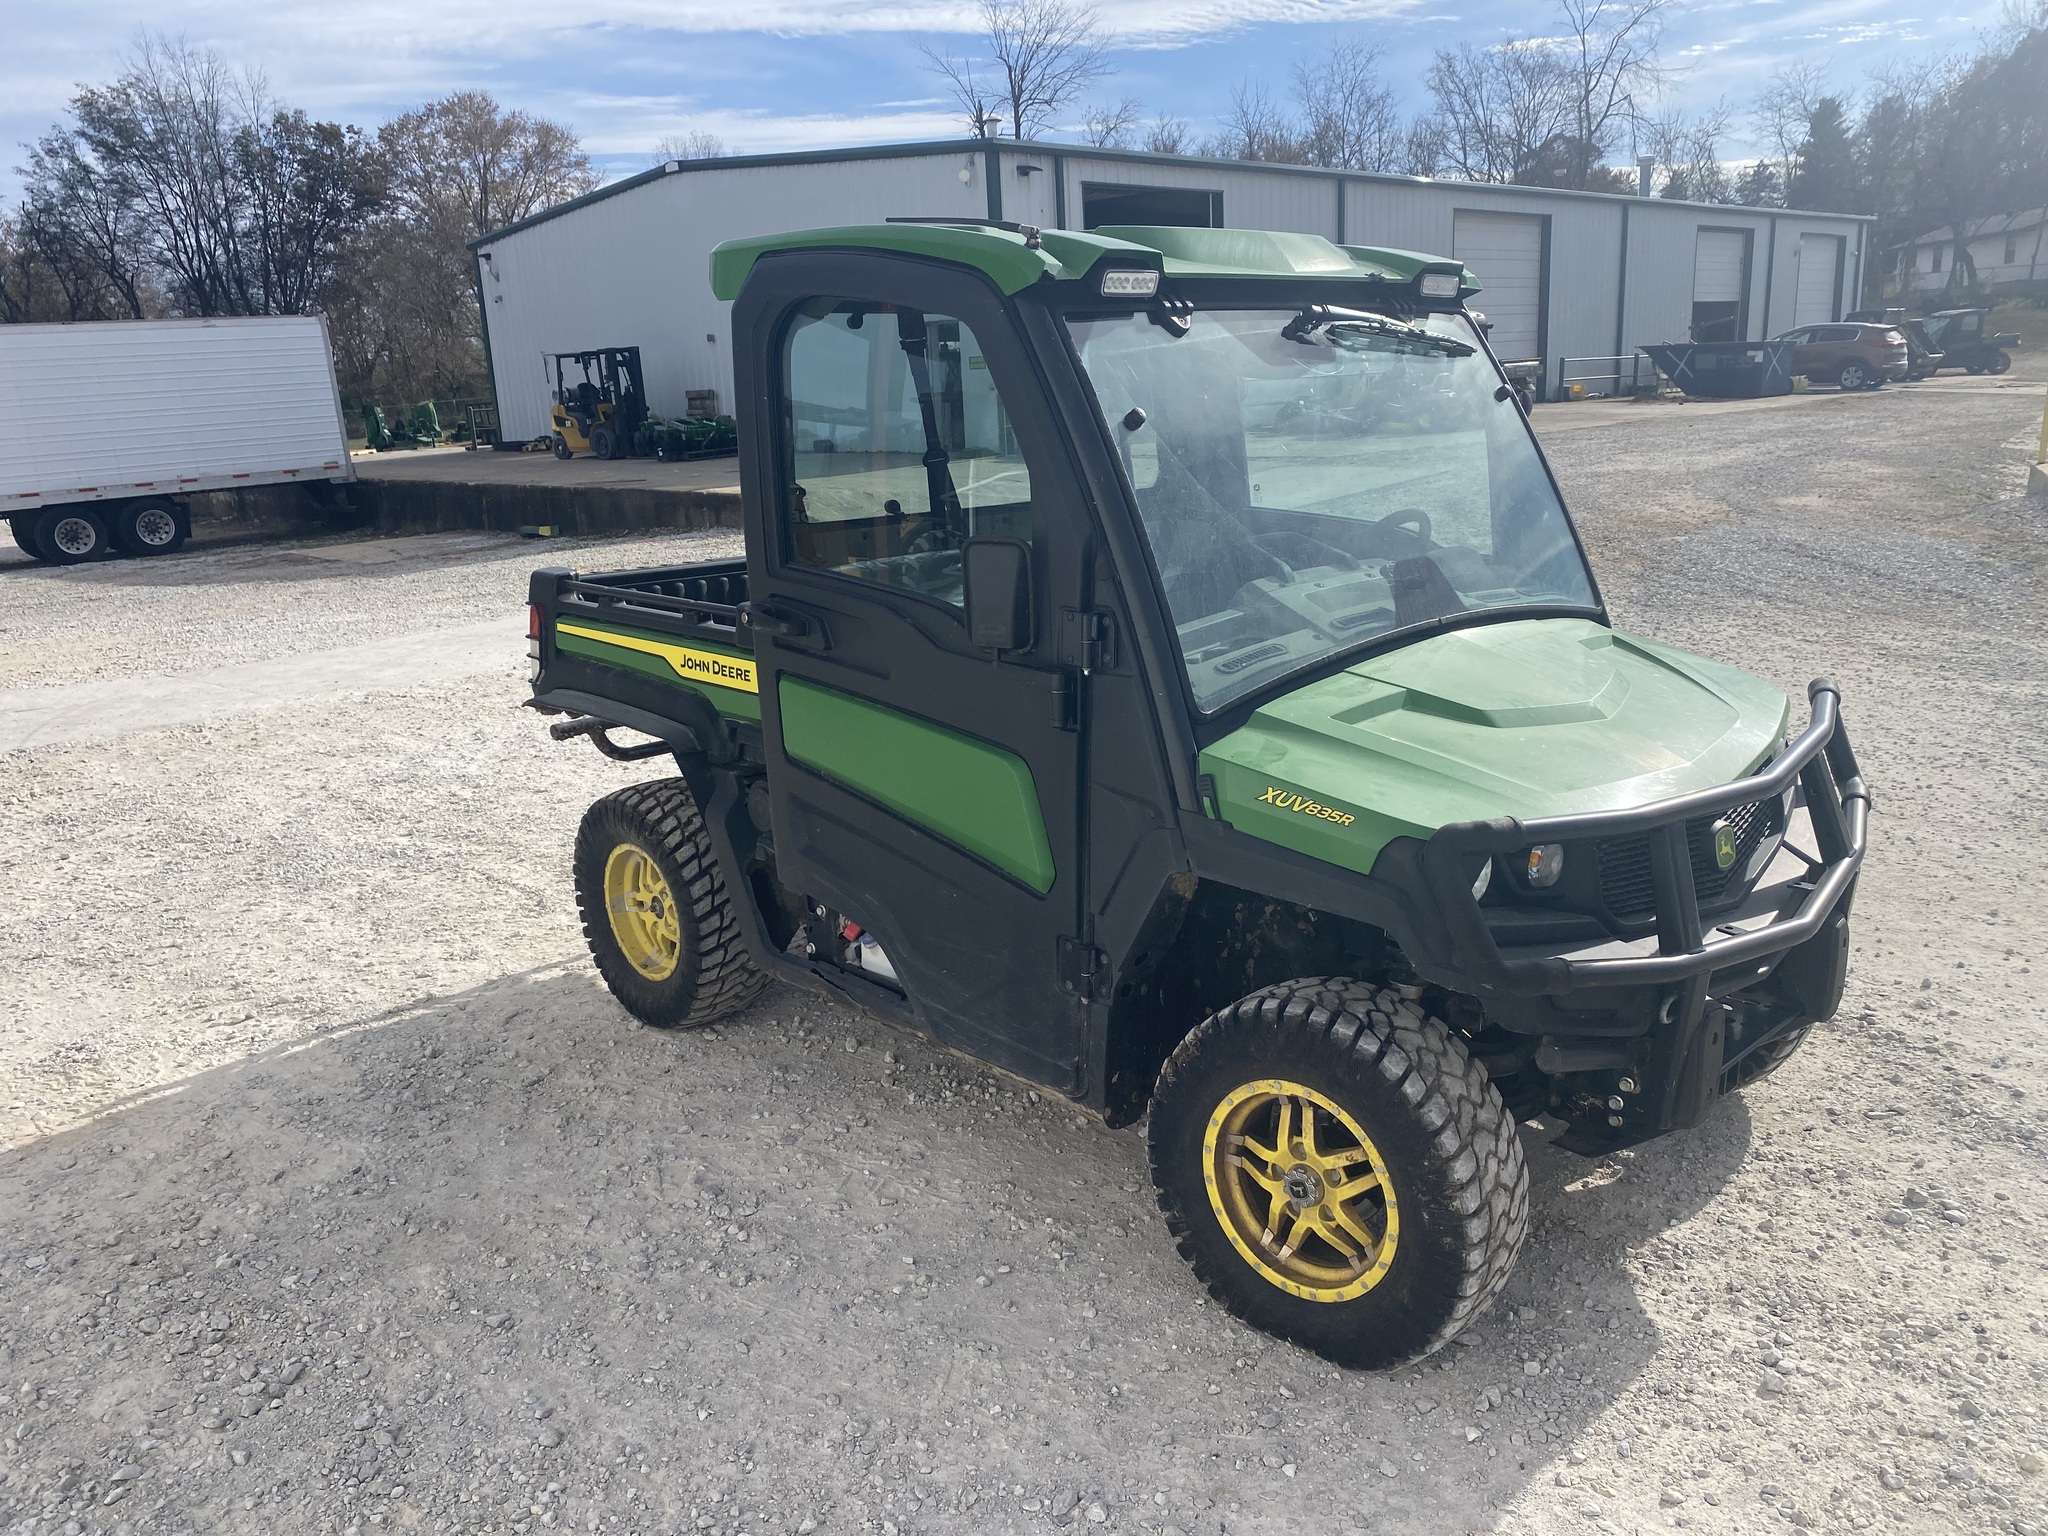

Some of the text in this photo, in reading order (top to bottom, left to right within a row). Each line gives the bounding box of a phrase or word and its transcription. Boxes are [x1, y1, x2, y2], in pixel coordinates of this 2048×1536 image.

[680, 654, 751, 682] JOHN DEERE
[1256, 786, 1356, 827] XUV835R
